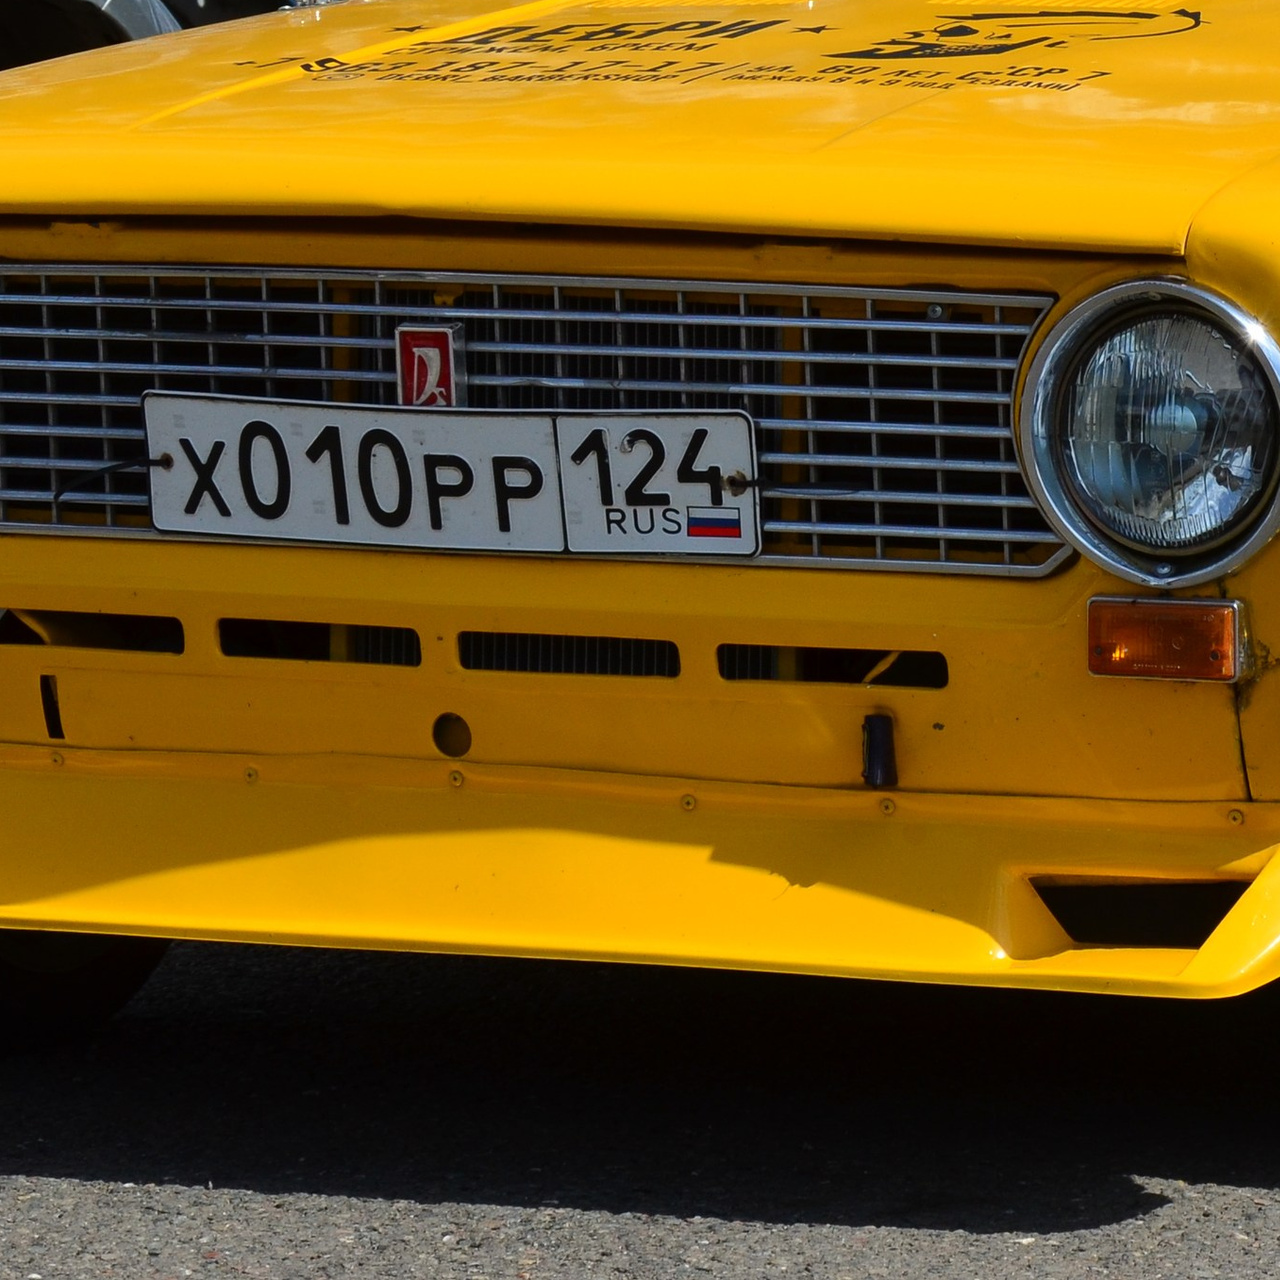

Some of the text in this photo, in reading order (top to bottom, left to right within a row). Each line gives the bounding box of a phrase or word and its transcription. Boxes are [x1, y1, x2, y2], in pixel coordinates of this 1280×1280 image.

[410, 19, 791, 47] ДЕБРИ
[584, 42, 719, 52] БРЕЕМ
[414, 60, 726, 73] 187-17-17
[817, 64, 882, 76] 60
[880, 70, 951, 80] ЛЕТ
[569, 427, 724, 508] 124
[606, 507, 683, 535] RUS
